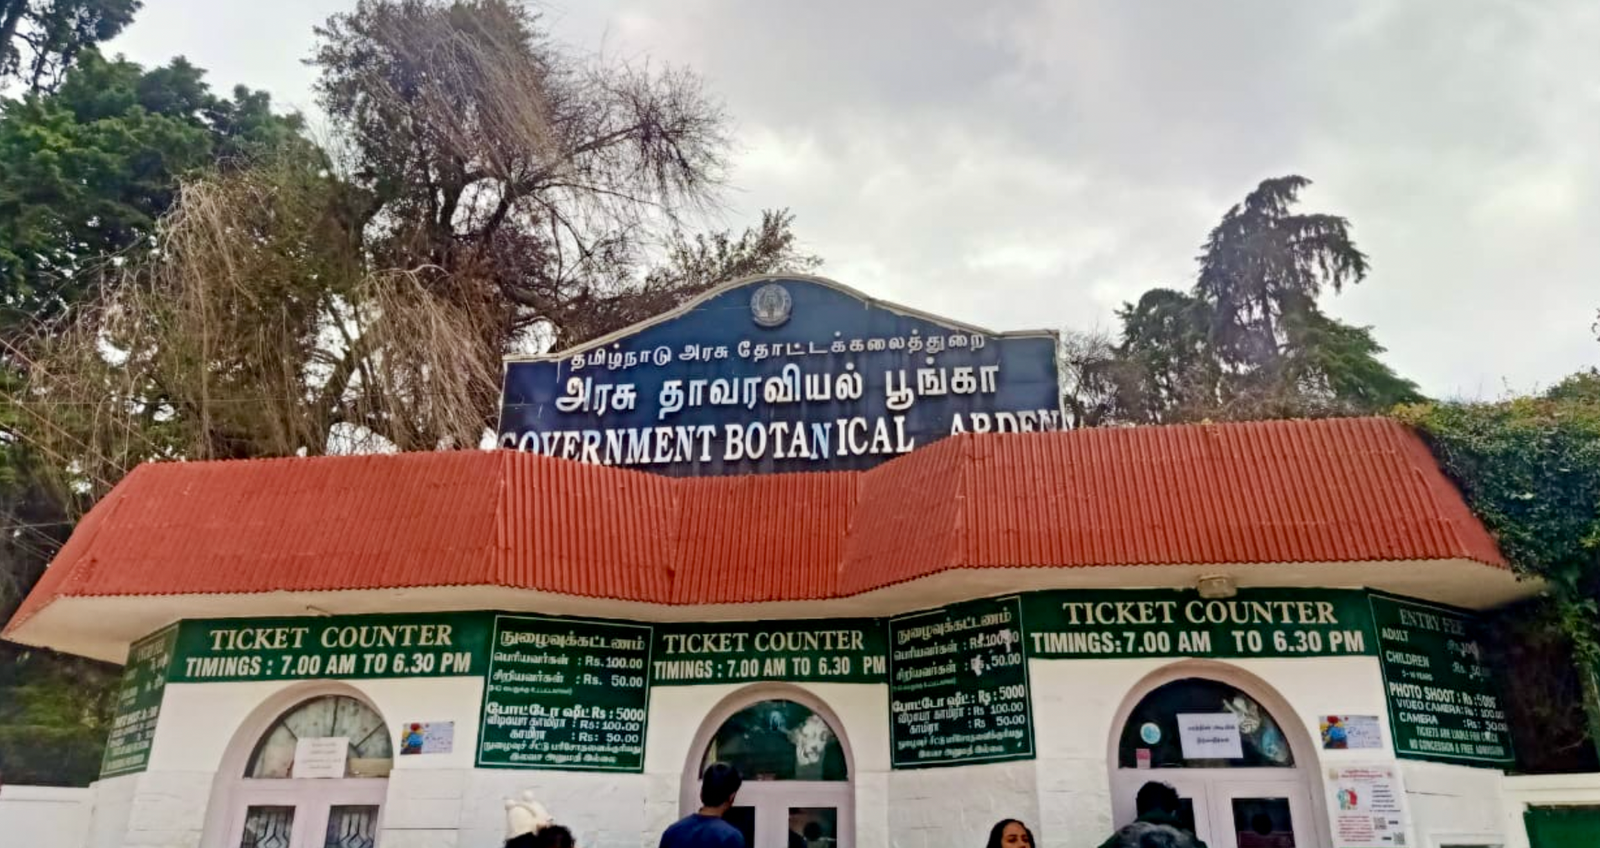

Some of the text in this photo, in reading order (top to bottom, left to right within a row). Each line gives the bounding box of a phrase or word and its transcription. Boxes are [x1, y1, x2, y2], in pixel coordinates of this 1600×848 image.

[570, 328, 986, 371] தமிழ்நாடு அரசு தோட்டக்கலைத்துறை
[555, 357, 1000, 420] அரசு தாவரவியல் பூங்கா
[723, 415, 916, 463] BOTANICAL
[1062, 600, 1339, 625] TICKET COUNTER
[1400, 608, 1441, 632] ENTRY
[897, 606, 1013, 645] நுழைவுக்கட்டணம்
[1381, 627, 1409, 643] ADULT
[209, 624, 454, 651] TICKET COUNTER
[499, 630, 646, 651] நுழைவுக்கட்டணம்
[662, 629, 865, 655] TICKET COUNTER
[1126, 631, 1171, 653] 7.00
[1177, 630, 1212, 653] AM
[1231, 629, 1263, 653] TO
[1273, 629, 1322, 653] 6.30
[1328, 629, 1365, 653] PM
[185, 656, 261, 678] TIMINGS
[281, 654, 321, 676] 7.00
[324, 653, 356, 675] AM
[363, 653, 388, 674] TO
[392, 652, 435, 674] 6.30
[440, 652, 473, 673] PM
[653, 660, 713, 680] TIMINGS
[727, 659, 759, 678] 7.00
[763, 658, 786, 677] AM
[791, 657, 811, 676] TO
[818, 657, 850, 675] 6.30
[863, 655, 887, 675] PM
[991, 653, 1022, 667] 50.00
[1386, 650, 1430, 668] CHILDREN
[611, 675, 643, 688] 50.00
[999, 684, 1025, 700] 5000
[1389, 681, 1422, 699] PHOTO
[1425, 686, 1455, 704] SHOOT
[591, 706, 606, 719] Rs
[616, 707, 644, 722] 5000
[990, 703, 1024, 716] 100.00
[1396, 698, 1424, 711] VIDEO
[602, 721, 640, 731] 100.00
[996, 714, 1027, 727] 50.00
[1399, 712, 1439, 725] CAMERA
[606, 732, 640, 743] 50.00
